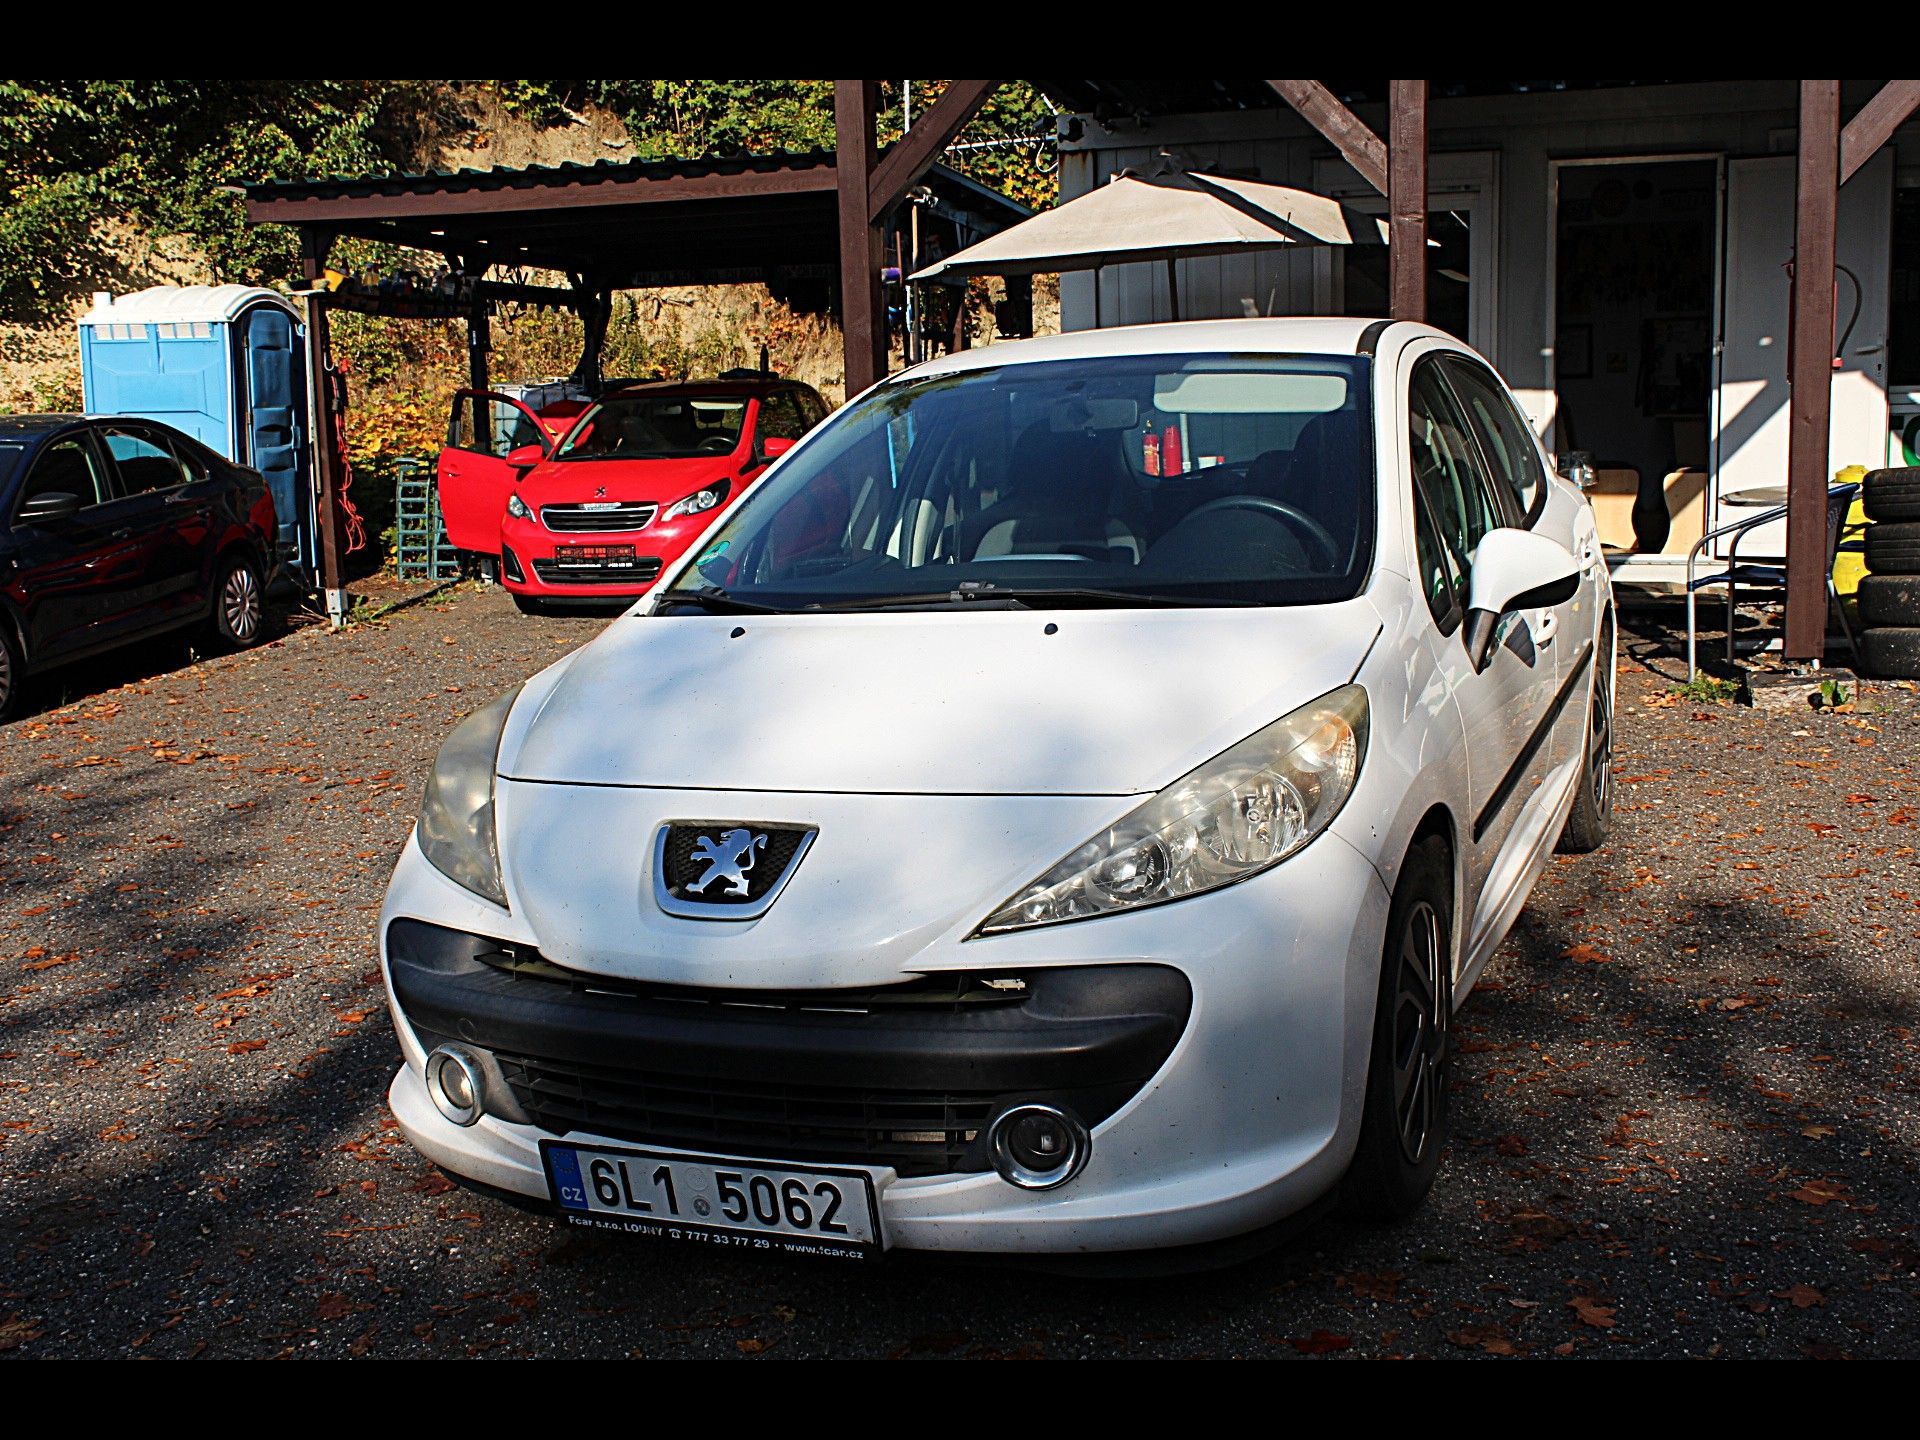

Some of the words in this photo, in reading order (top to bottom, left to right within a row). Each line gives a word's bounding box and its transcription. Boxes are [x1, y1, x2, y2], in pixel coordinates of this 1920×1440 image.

[561, 1186, 583, 1202] CZ
[590, 1158, 679, 1215] 6L1
[714, 1170, 848, 1234] 5062
[568, 1215, 593, 1227] Fcar
[685, 1230, 708, 1242] 777
[713, 1235, 730, 1244] 33
[732, 1236, 749, 1246] 77
[753, 1239, 770, 1249] 29
